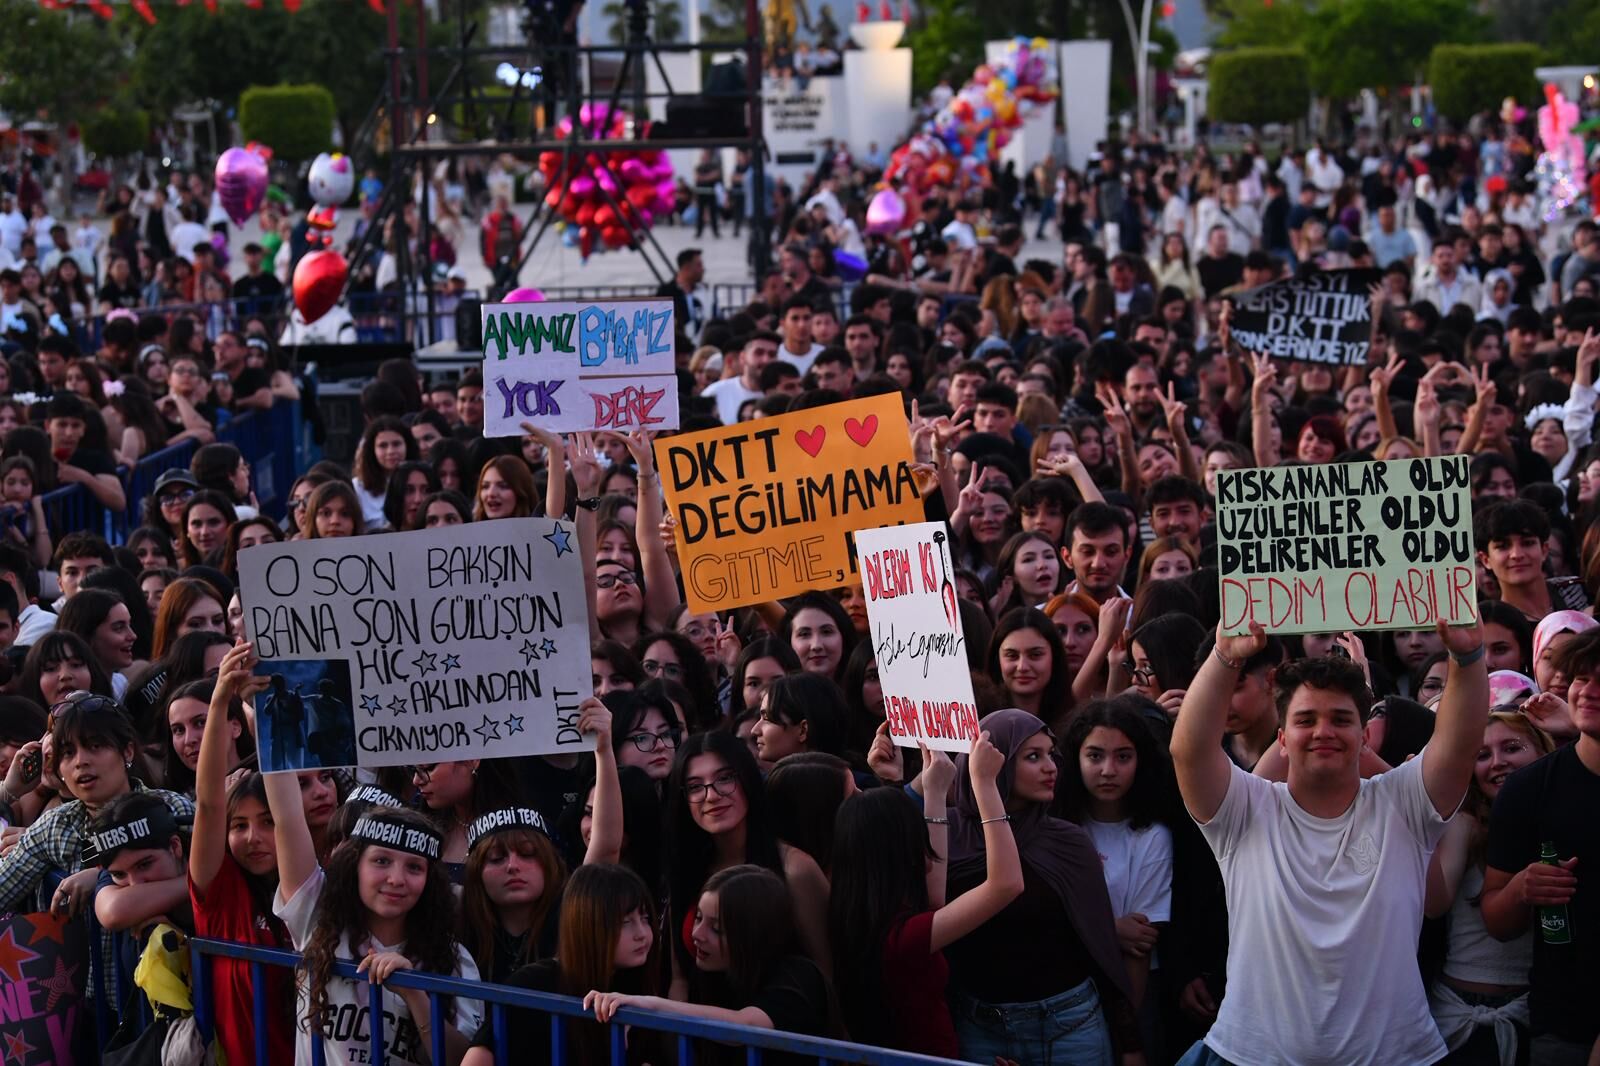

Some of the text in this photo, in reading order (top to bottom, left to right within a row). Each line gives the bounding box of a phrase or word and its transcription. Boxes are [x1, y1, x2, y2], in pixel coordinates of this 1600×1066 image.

[1291, 290, 1371, 322] TUTTUK
[482, 305, 672, 367] ANAMIZ BABAMIZ
[496, 377, 565, 419] YOK
[668, 428, 780, 492] DKTT
[1218, 456, 1469, 504] KISKANANLAR OLDU
[1219, 493, 1460, 541] ÜZÜLENLER OLDU
[266, 543, 532, 597] O SON BAKIŞIN
[1221, 531, 1470, 575] DELİRENLER OLDU
[252, 591, 563, 659] BANA SON GÜLÜŞÜN
[1221, 576, 1326, 630] DEDİM
[356, 644, 410, 689] HİÇ
[409, 668, 543, 715] AKLIMDAN
[553, 686, 583, 746] DKTT
[922, 700, 980, 741] OLMAKTAN
[98, 826, 129, 851] TERS
[128, 818, 151, 840] TUT
[362, 819, 405, 845] KADEHİ
[405, 829, 429, 852] TERS
[427, 836, 440, 858] TUT
[476, 806, 517, 836] KADEHİ
[517, 808, 541, 827] TERS
